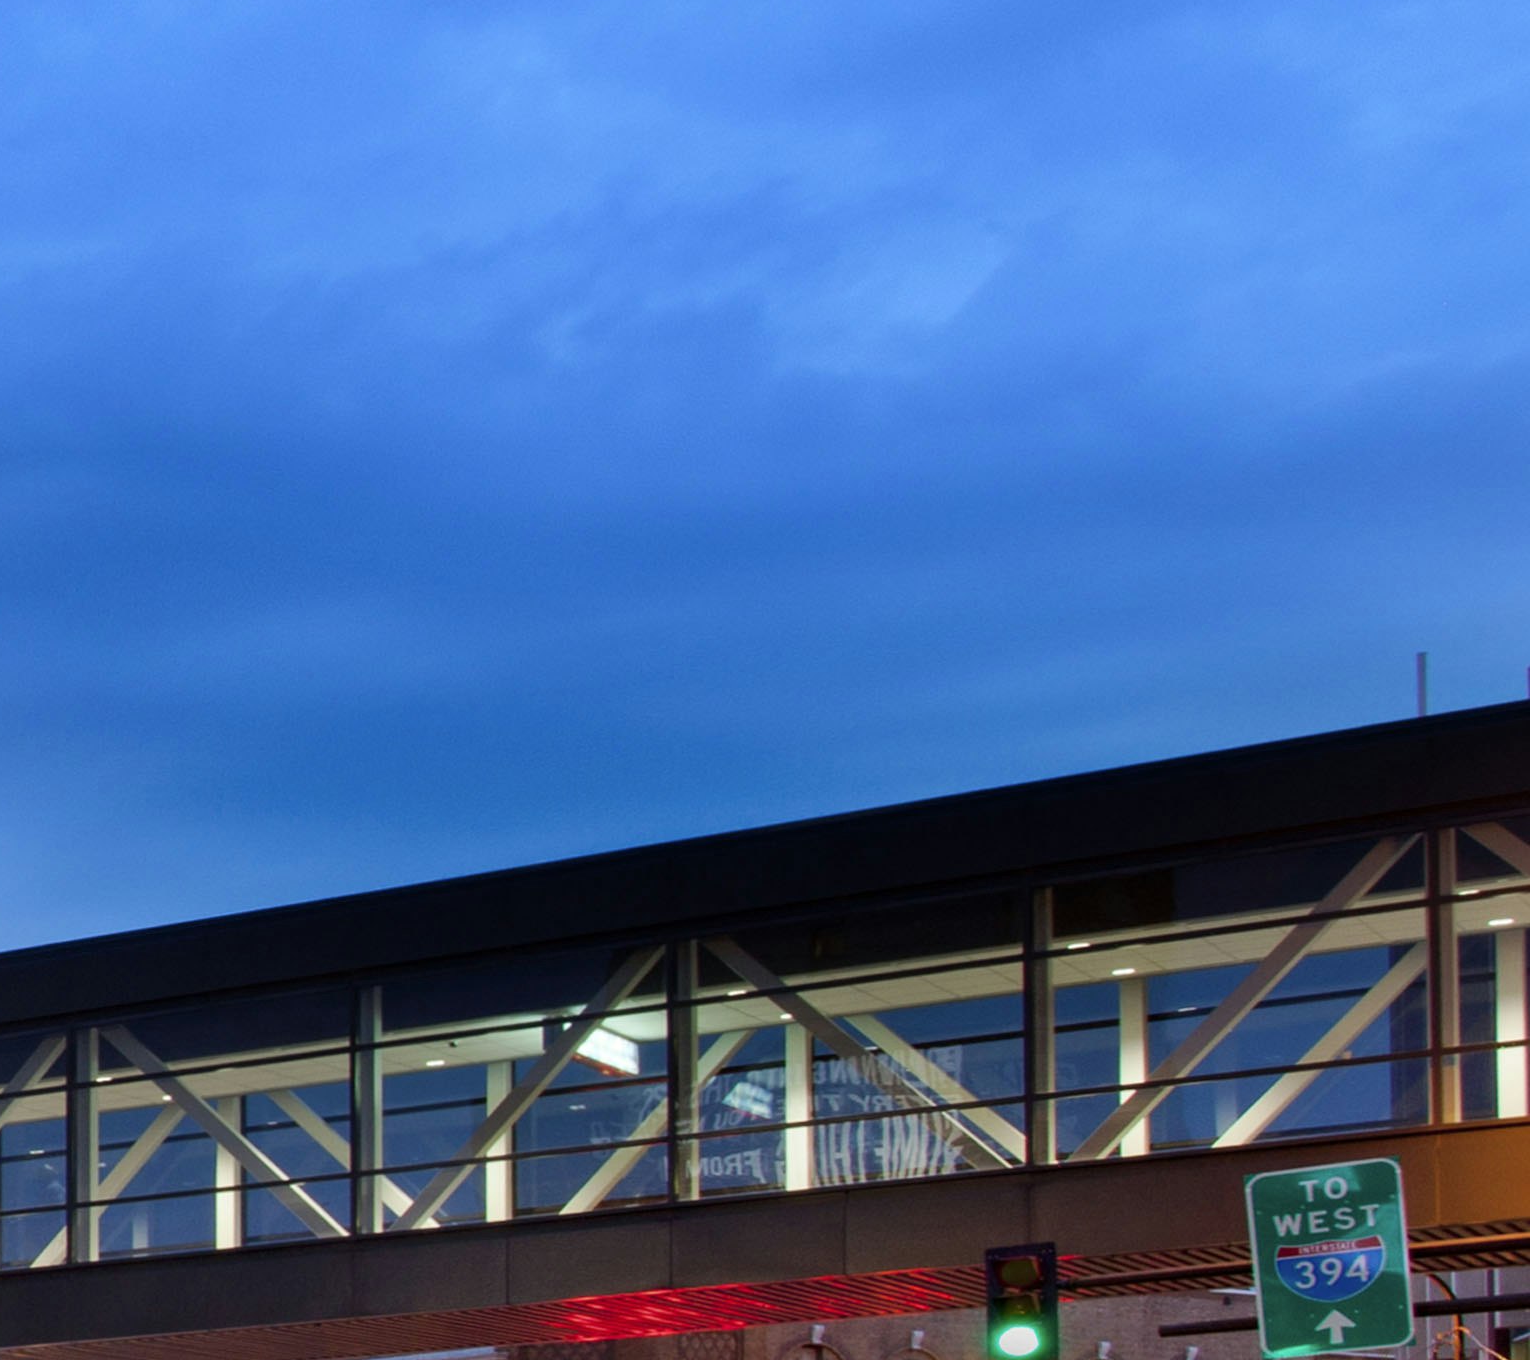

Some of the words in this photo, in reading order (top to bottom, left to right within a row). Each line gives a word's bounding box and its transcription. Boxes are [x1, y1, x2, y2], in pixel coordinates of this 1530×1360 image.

[1299, 1176, 1348, 1202] TO
[1272, 1204, 1380, 1237] WEST
[1298, 1241, 1358, 1255] INTERSTATE
[1295, 1254, 1370, 1289] 394
